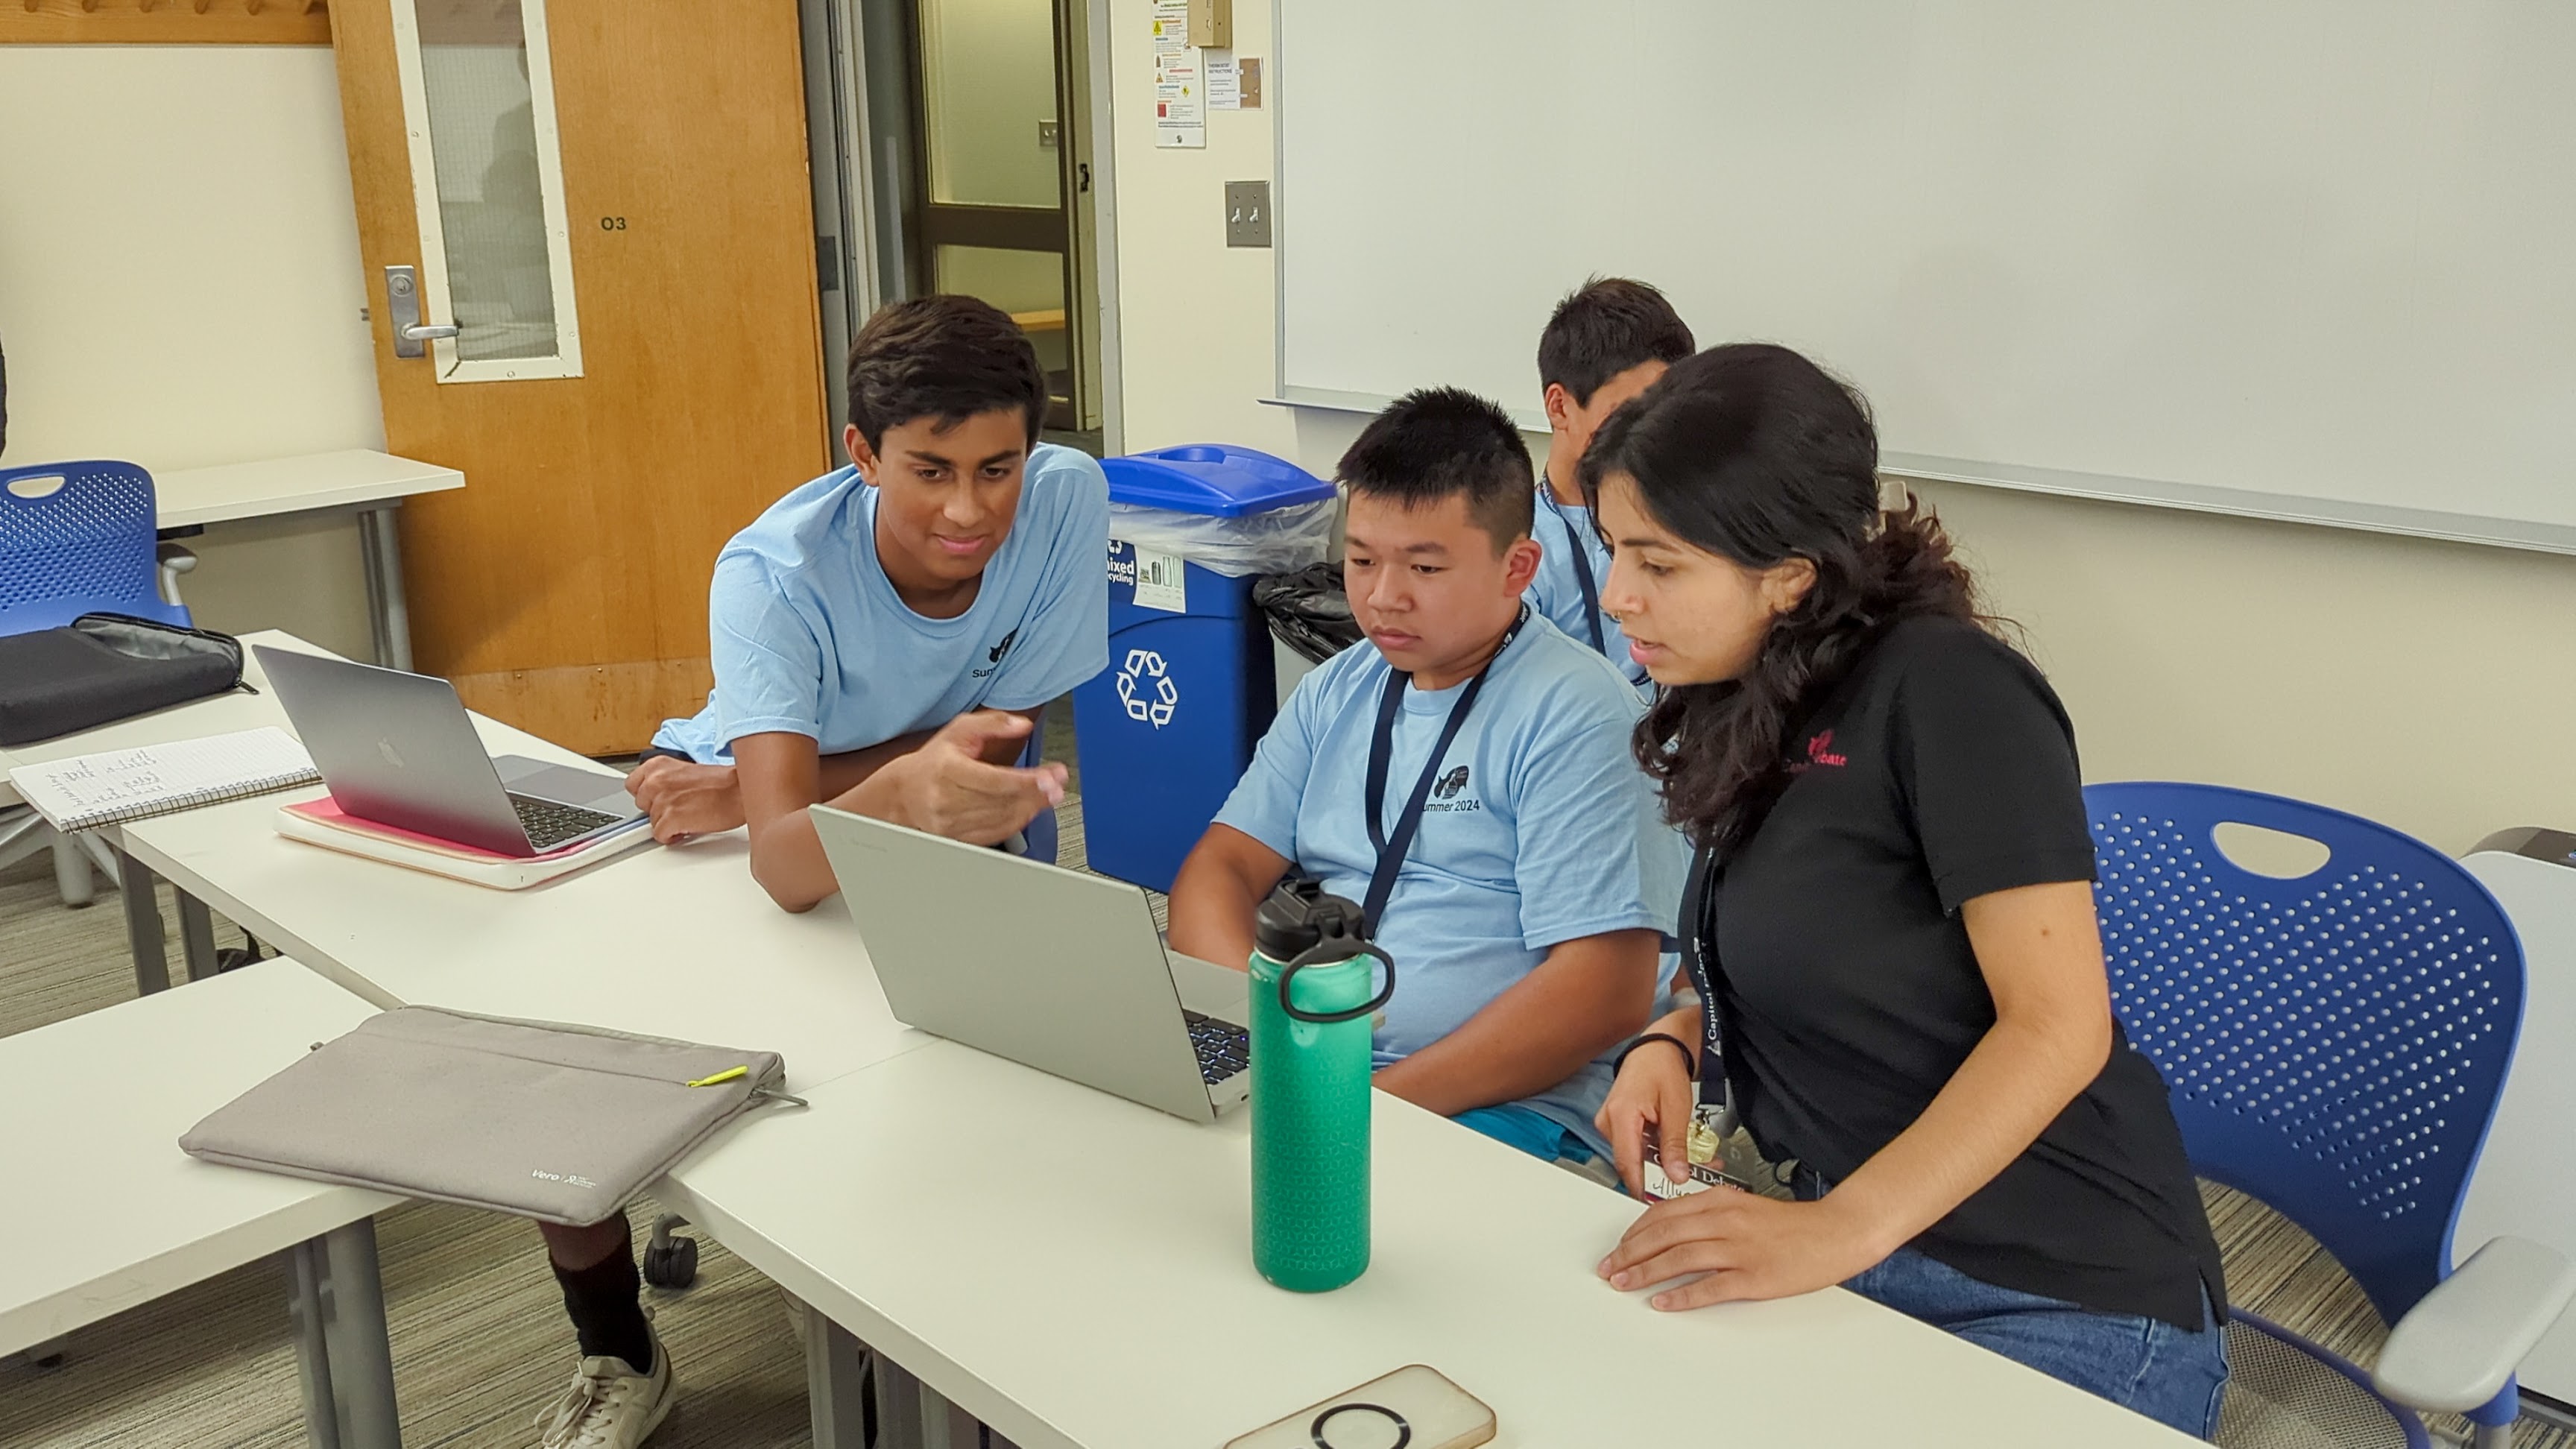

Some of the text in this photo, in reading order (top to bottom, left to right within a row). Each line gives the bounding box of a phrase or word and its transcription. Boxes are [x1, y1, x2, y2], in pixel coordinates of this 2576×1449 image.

[1108, 573, 1134, 586] cycling
[1423, 800, 1480, 812] ummer 2024
[532, 1169, 560, 1181] Vero
